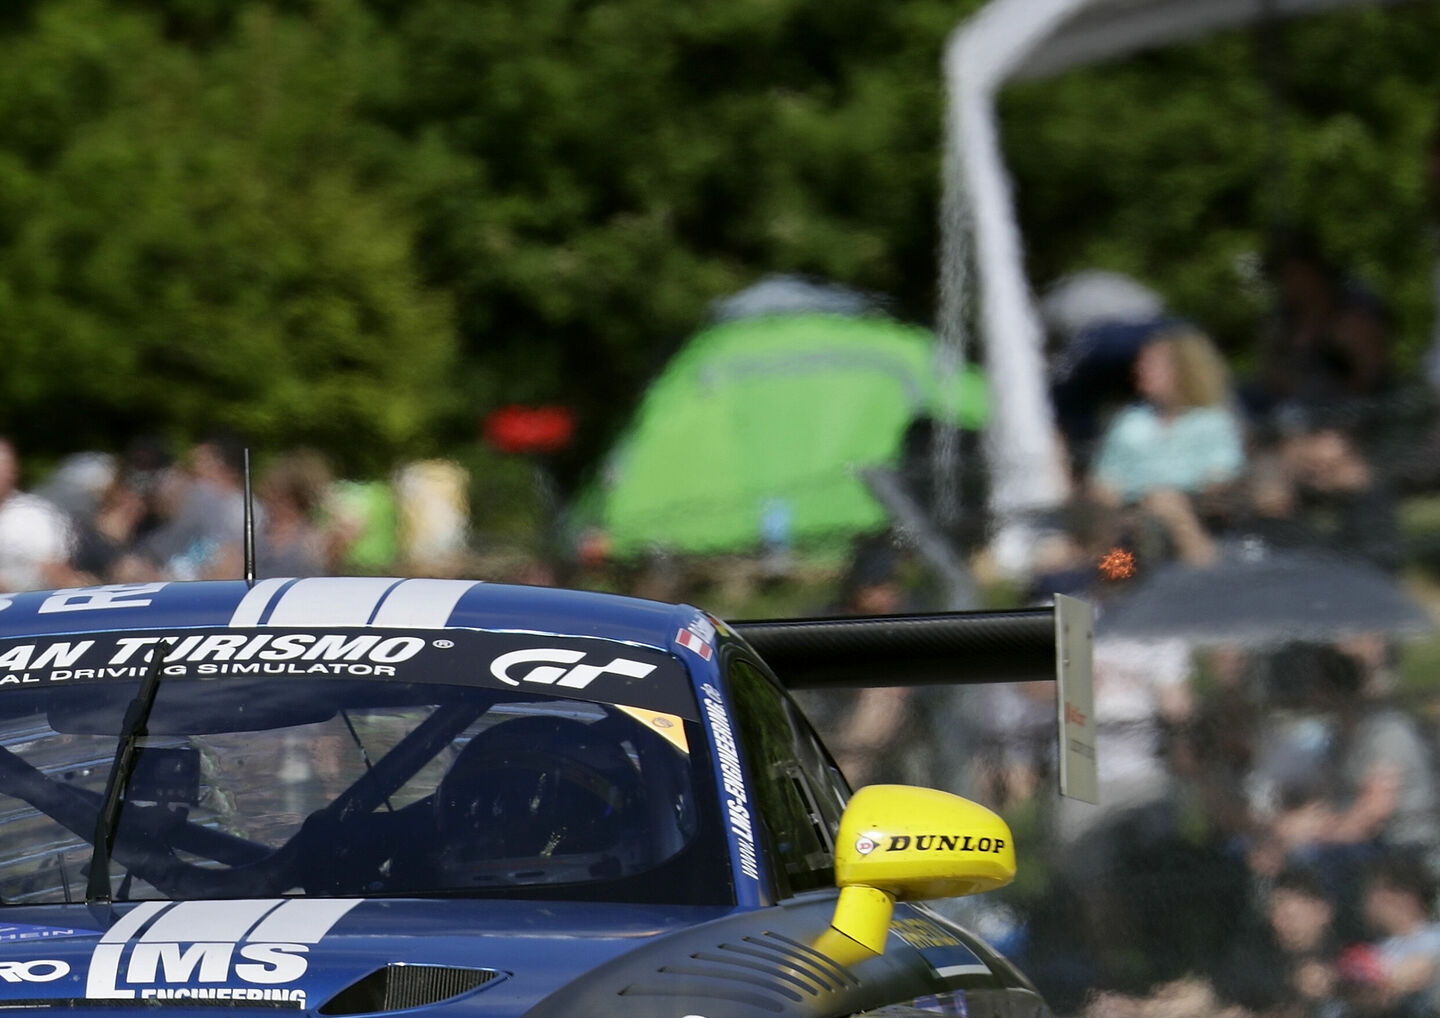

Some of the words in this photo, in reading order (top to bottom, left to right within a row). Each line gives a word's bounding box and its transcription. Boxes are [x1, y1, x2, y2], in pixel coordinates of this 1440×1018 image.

[197, 663, 396, 677] SIMULATOR
[886, 835, 1005, 854] DUNLOP
[85, 943, 310, 999] LMS
